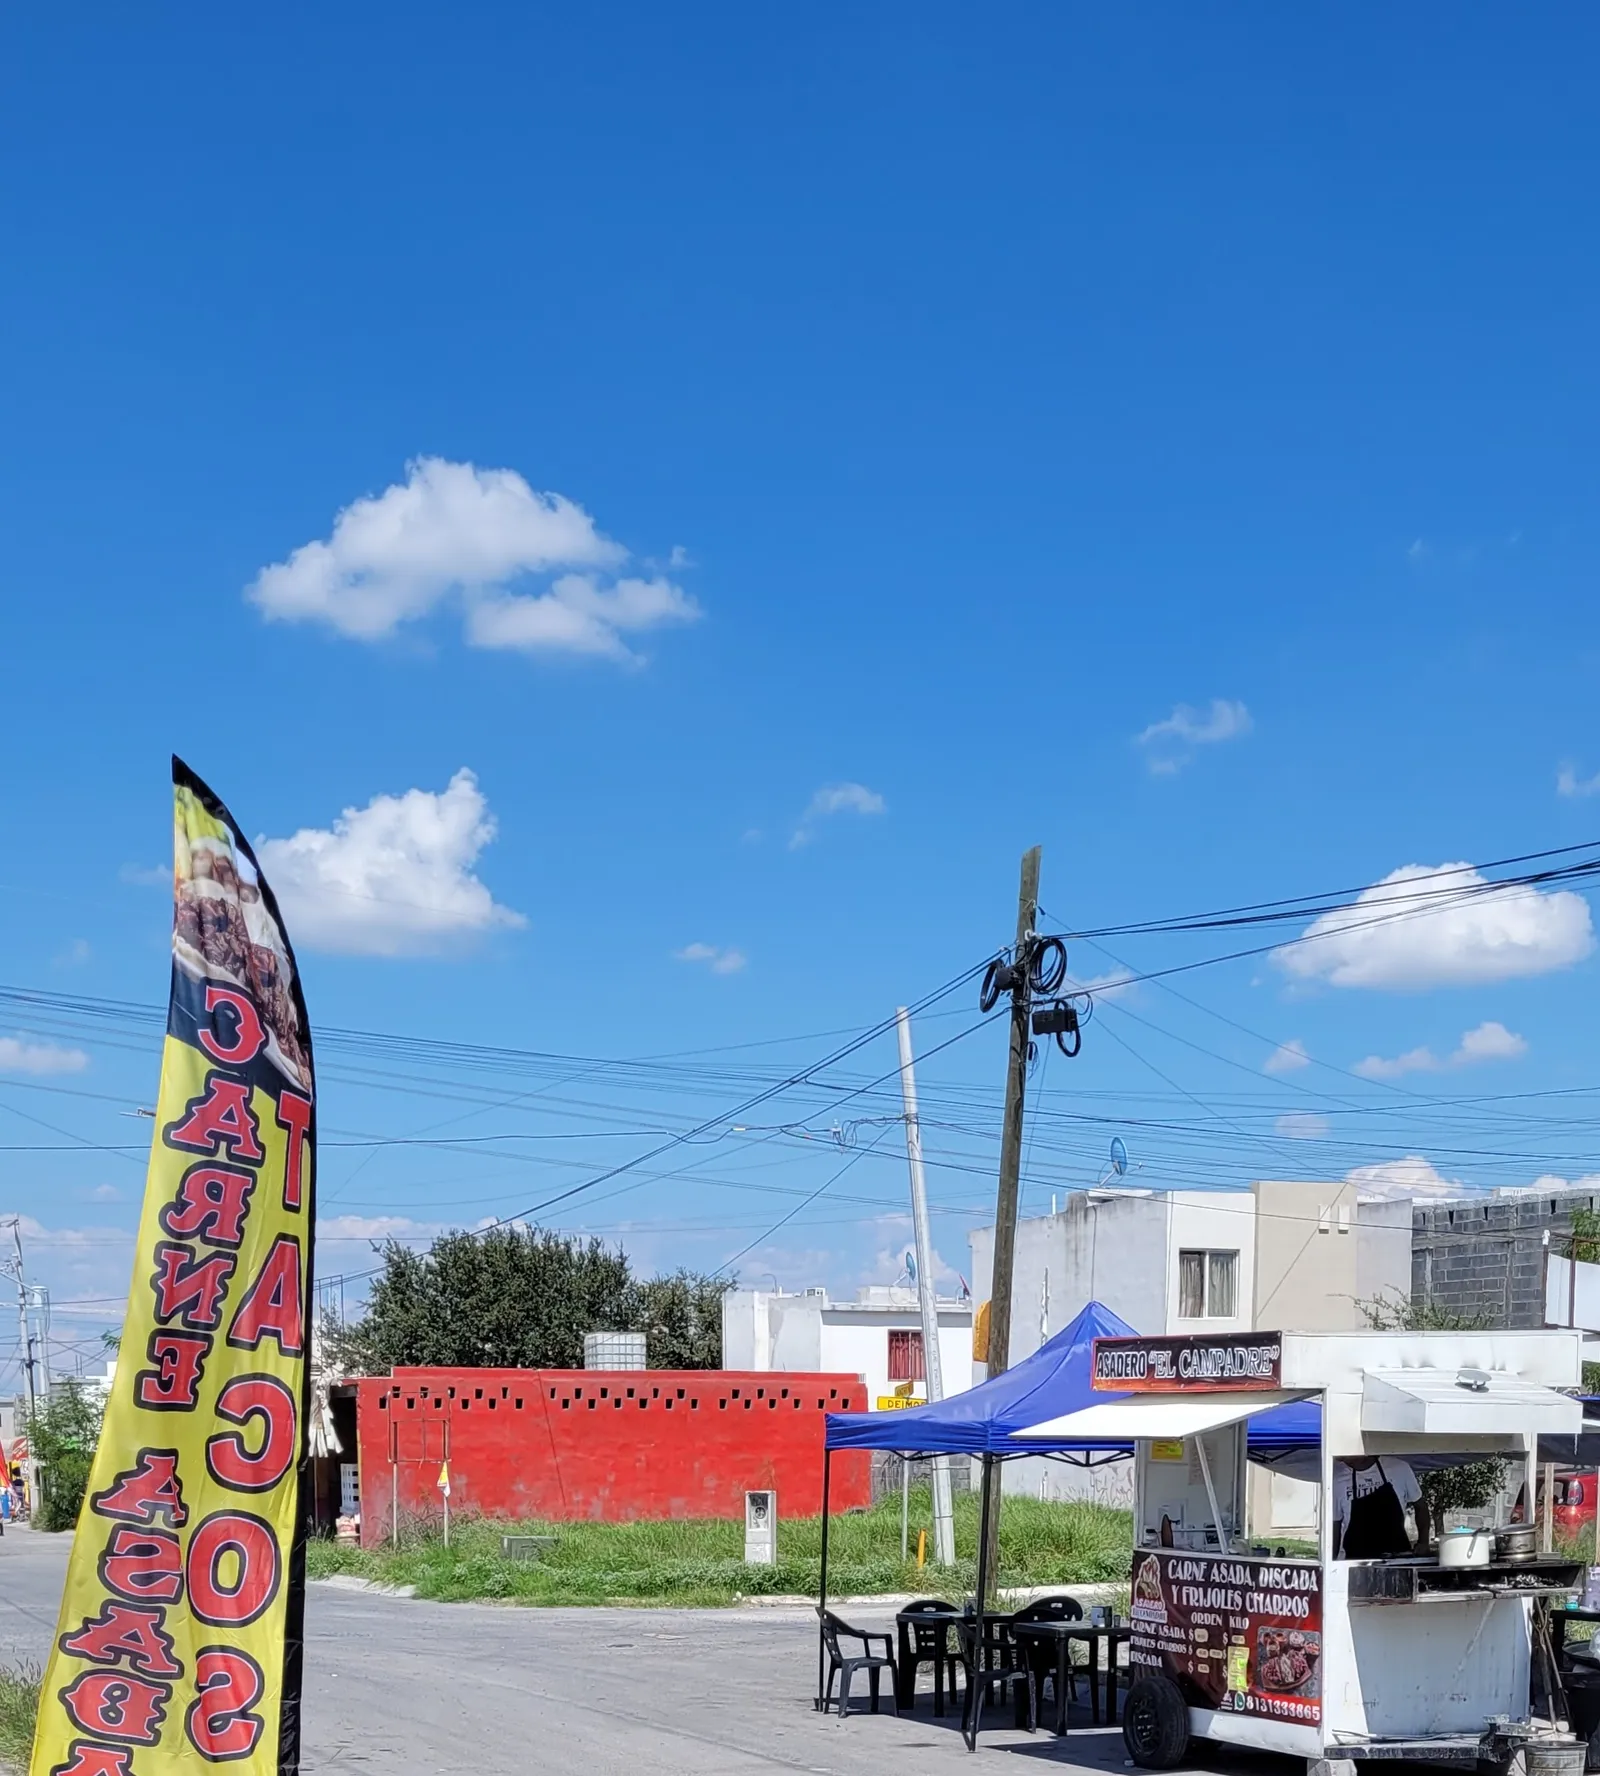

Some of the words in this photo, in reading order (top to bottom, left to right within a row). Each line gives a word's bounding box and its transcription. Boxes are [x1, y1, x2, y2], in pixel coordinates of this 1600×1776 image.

[1095, 1352, 1147, 1379] ASADERO
[1168, 1559, 1207, 1582] CARNE
[1210, 1561, 1256, 1590] ASADA,
[1259, 1567, 1319, 1592] DISCADA
[1171, 1585, 1179, 1605] Y
[1182, 1586, 1243, 1611] FRIJOLES
[1245, 1592, 1310, 1618] CHARROS
[1159, 1625, 1186, 1640] ASADA
[1191, 1611, 1223, 1626] ORDEN
[1229, 1615, 1250, 1630] KILO
[1130, 1650, 1163, 1667] DISCADA
[1246, 1695, 1320, 1720] 8131333865
